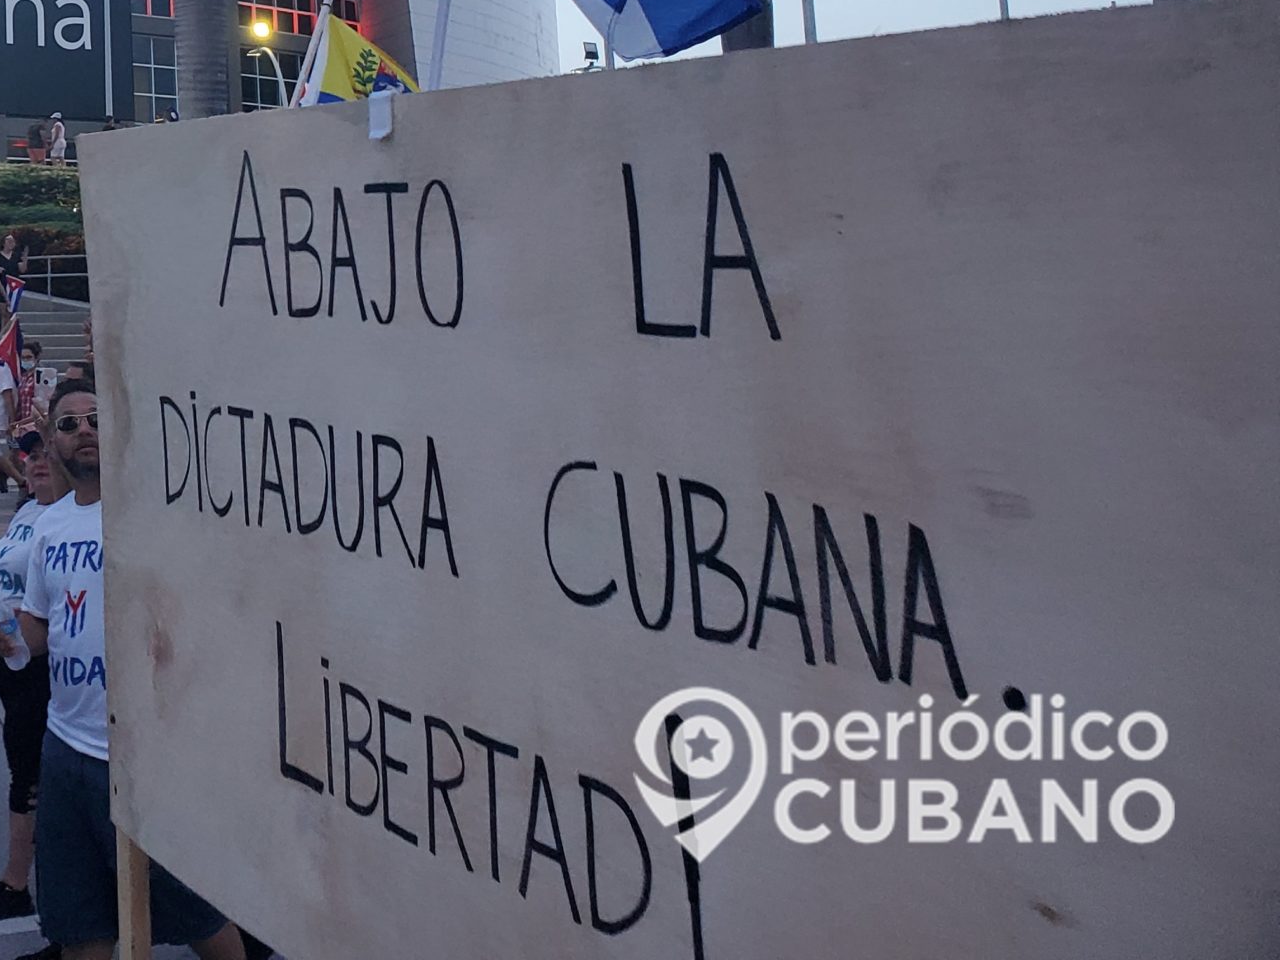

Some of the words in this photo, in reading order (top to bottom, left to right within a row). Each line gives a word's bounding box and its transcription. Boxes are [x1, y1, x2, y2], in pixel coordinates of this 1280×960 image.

[219, 150, 465, 330] ABAJO
[621, 151, 782, 341] LA
[51, 655, 107, 691] VIDA
